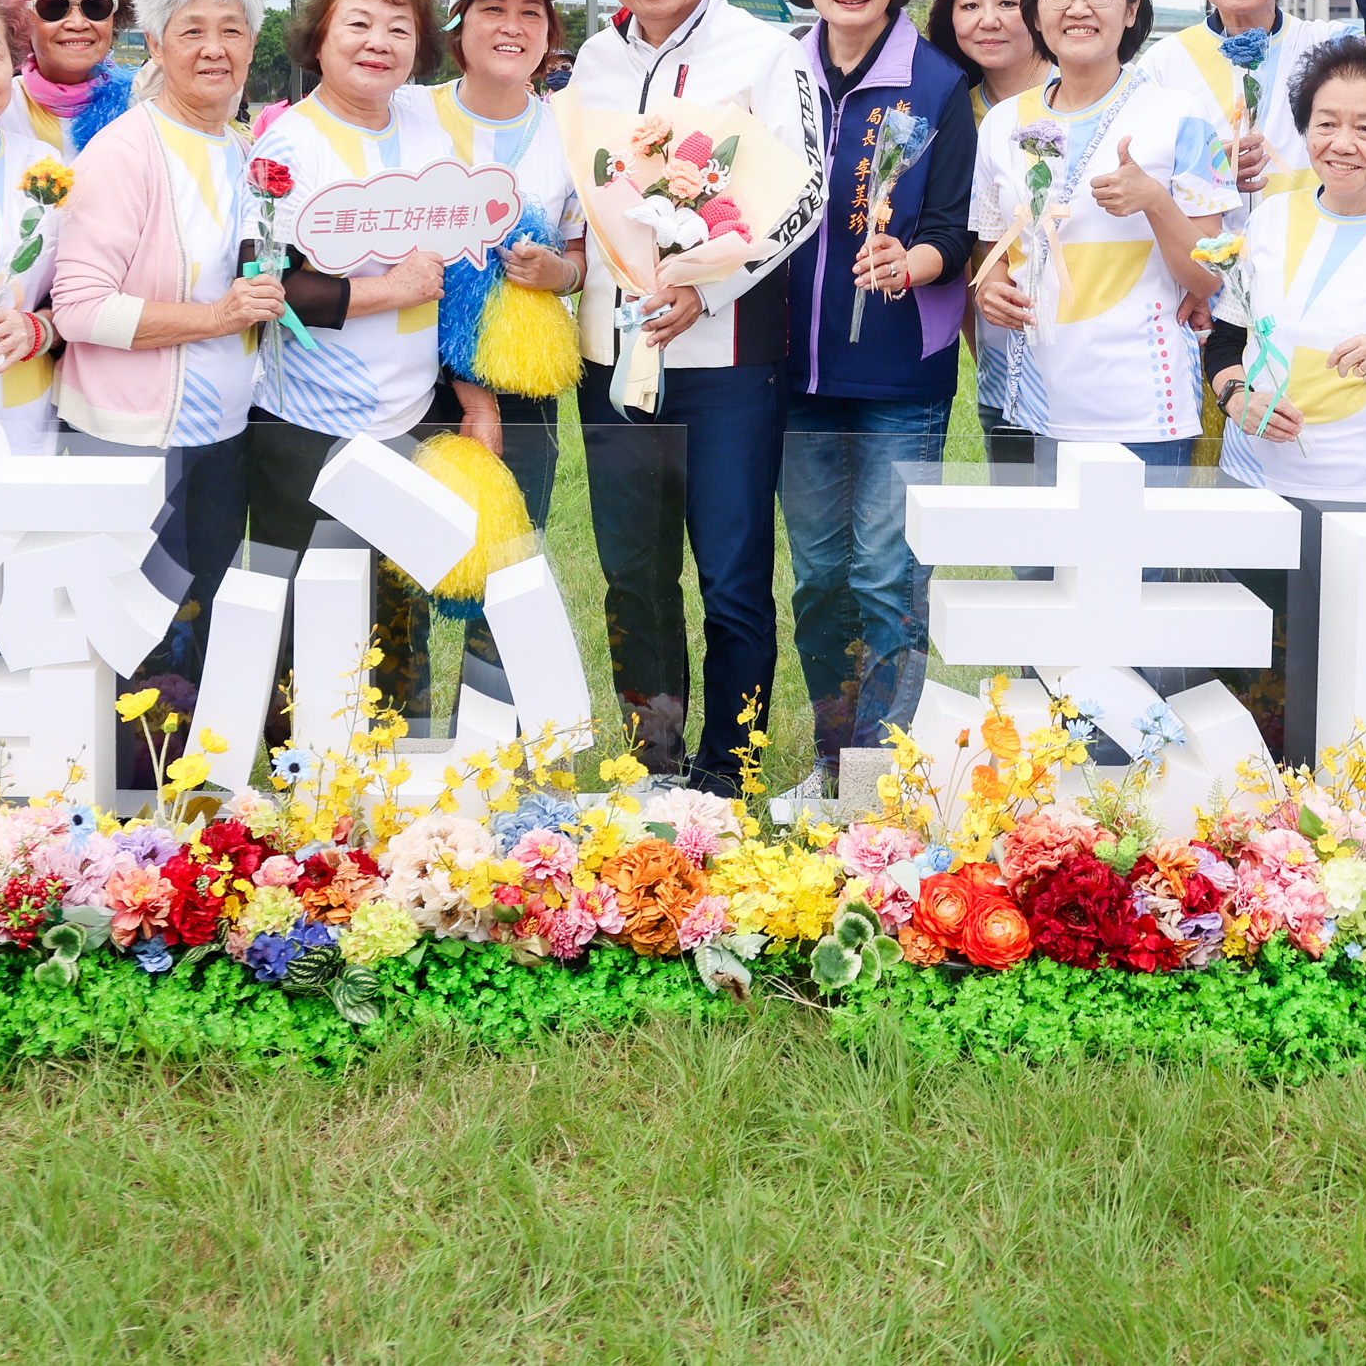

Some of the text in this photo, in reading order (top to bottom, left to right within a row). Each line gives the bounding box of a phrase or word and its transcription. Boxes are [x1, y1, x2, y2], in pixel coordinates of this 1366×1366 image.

[796, 72, 816, 130] NEW
[848, 107, 882, 236] 局長 李美珍
